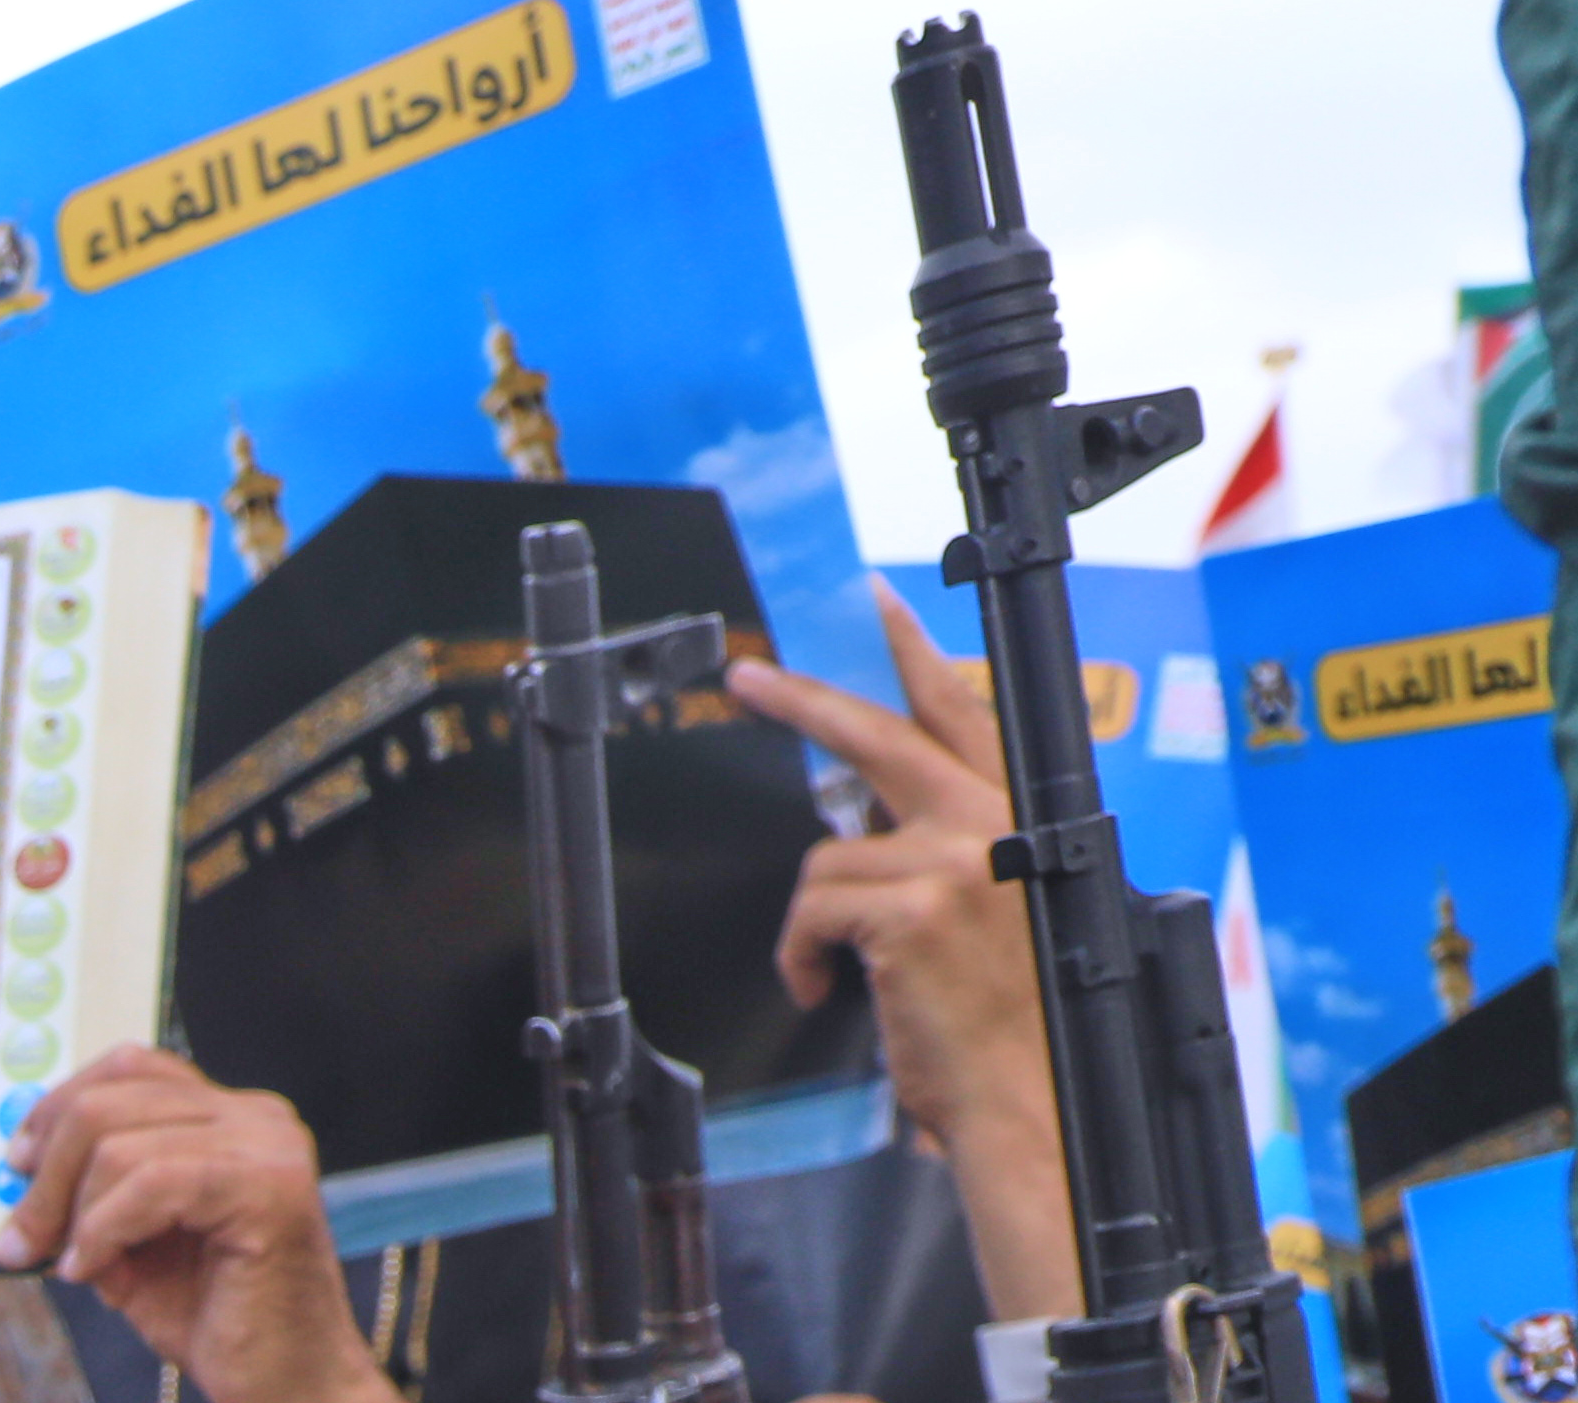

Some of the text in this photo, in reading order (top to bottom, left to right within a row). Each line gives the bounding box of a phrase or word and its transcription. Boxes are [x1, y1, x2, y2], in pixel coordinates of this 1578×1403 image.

[359, 6, 551, 152] أرواحنا
[252, 107, 344, 195] لها
[86, 150, 241, 266] الفداء
[1335, 634, 1539, 721] لها الفداء
